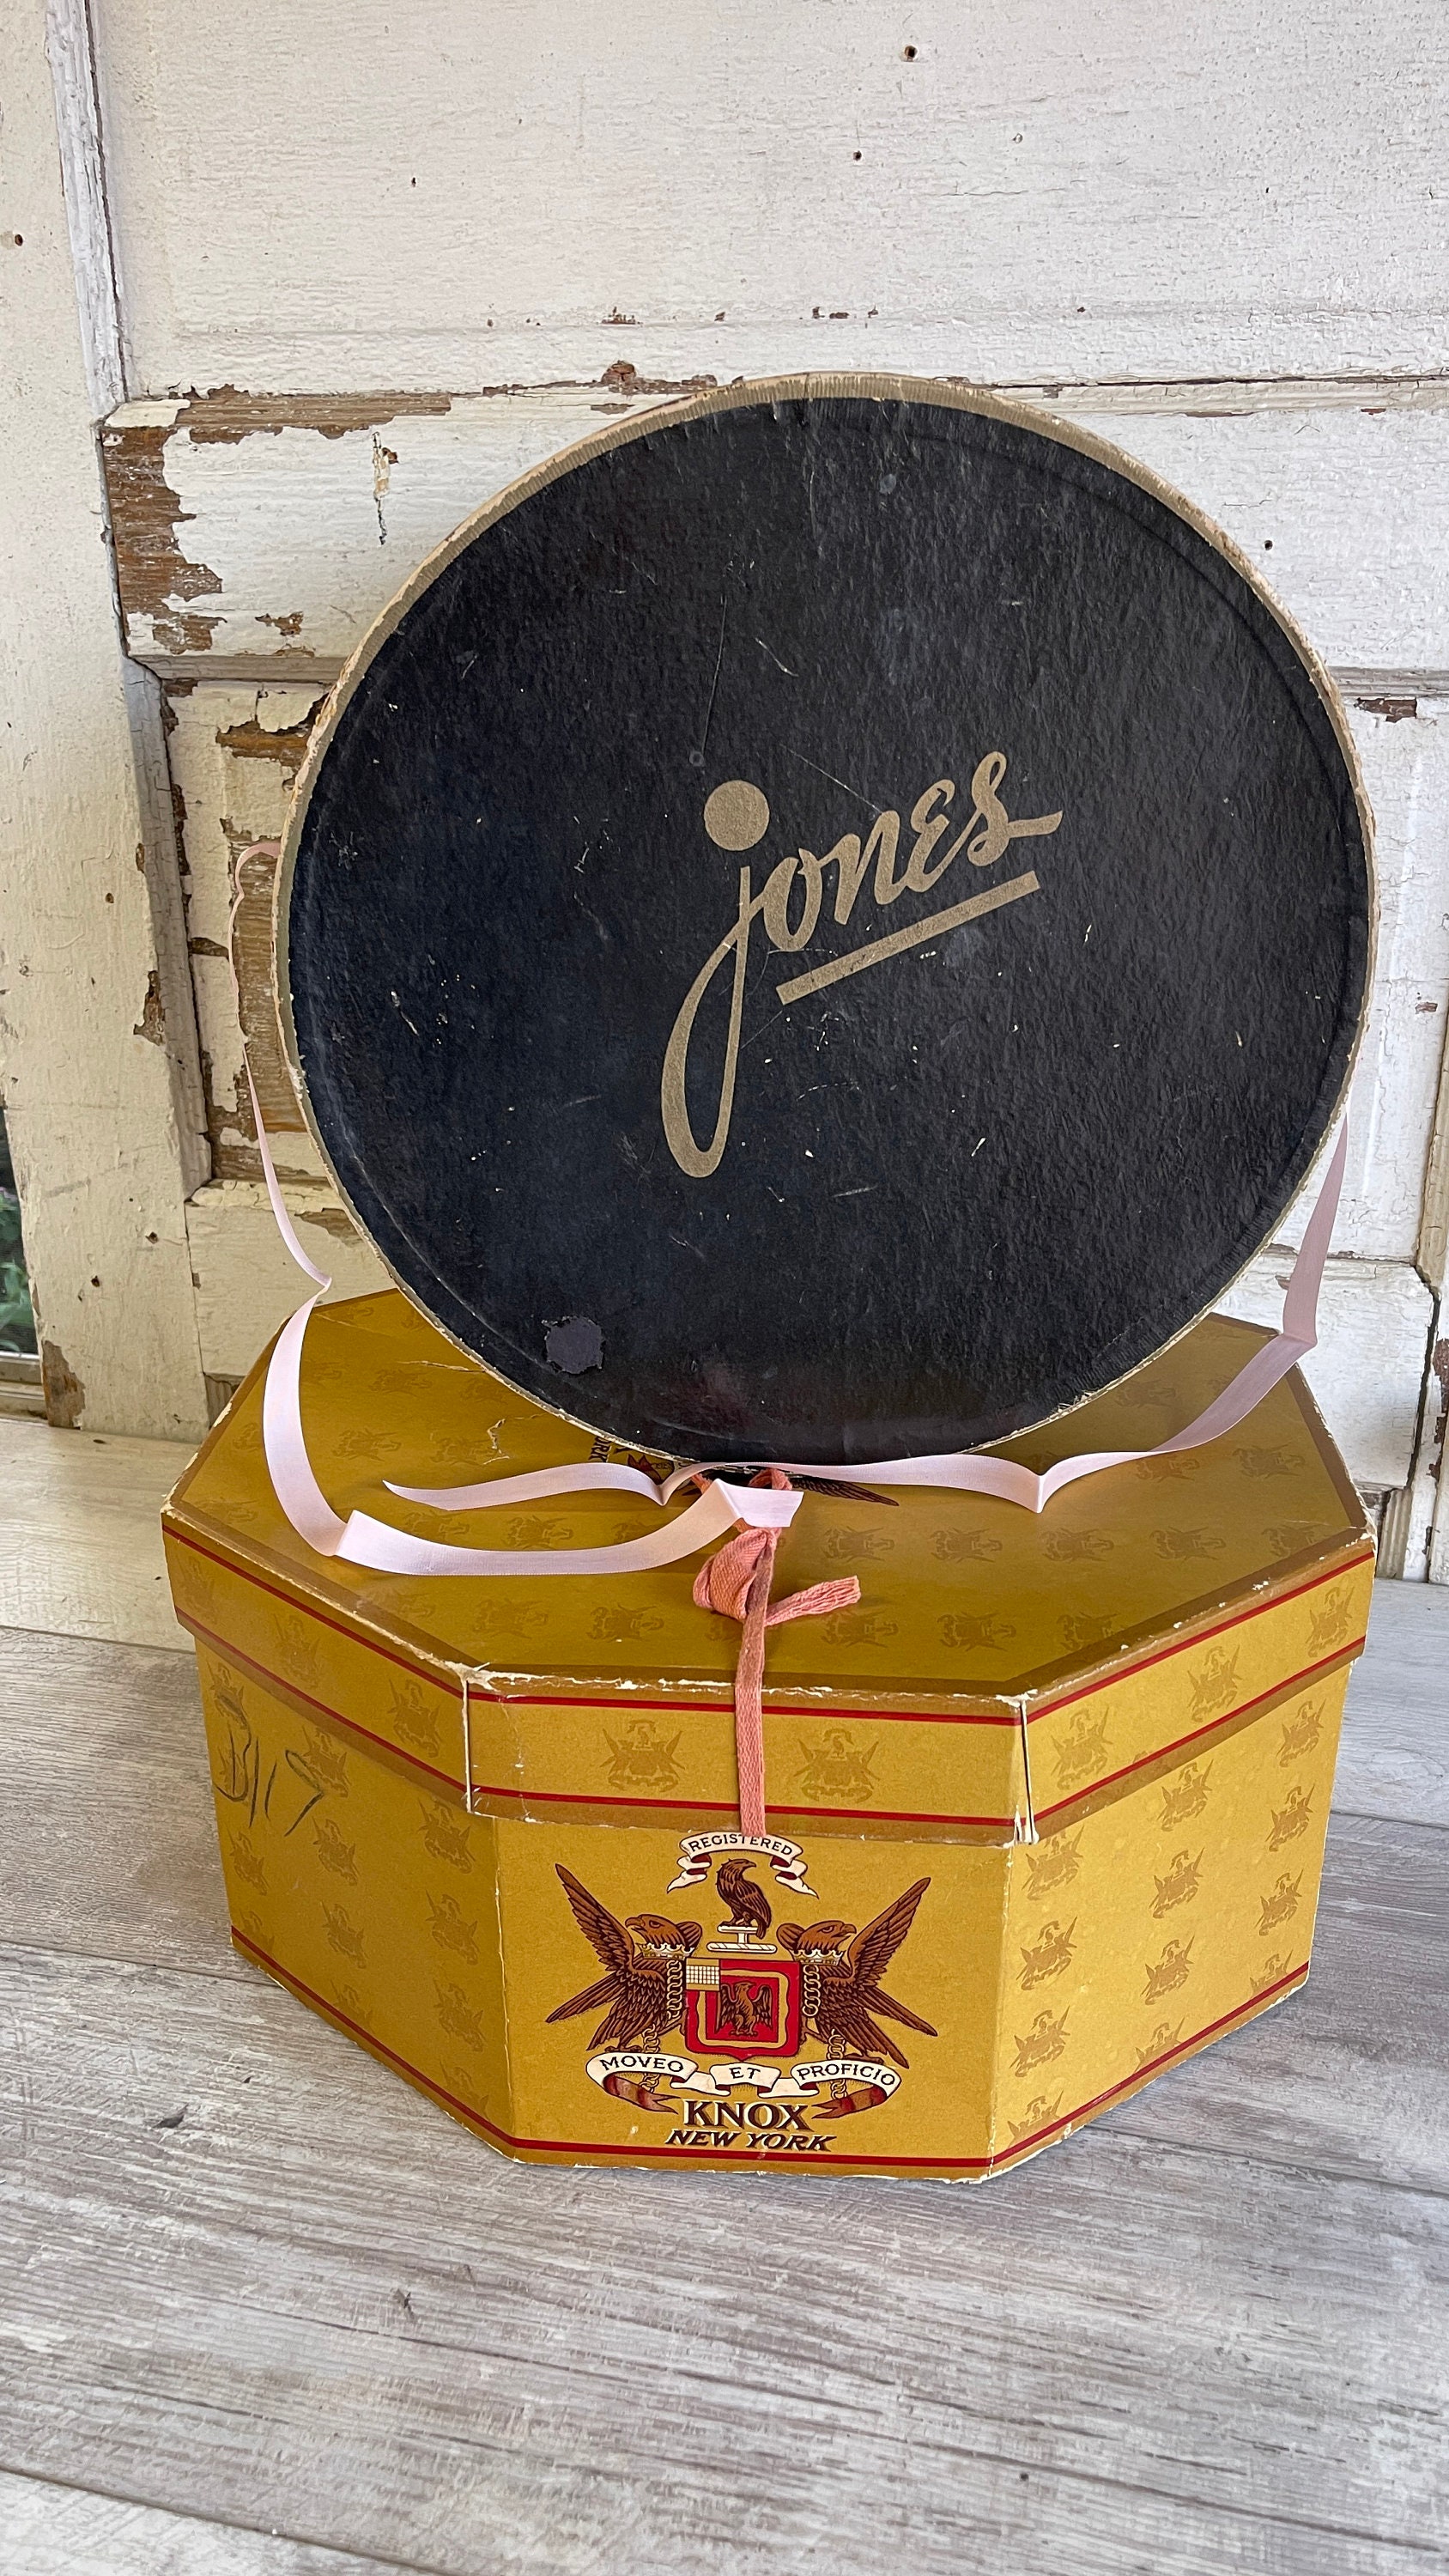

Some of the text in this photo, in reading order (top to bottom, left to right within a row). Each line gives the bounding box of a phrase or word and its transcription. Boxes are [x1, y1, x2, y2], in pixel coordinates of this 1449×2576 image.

[661, 750, 1063, 1178] jones
[688, 1833, 793, 1856] REGISTERED
[600, 2055, 896, 2087] MOVEO ET PROFICIO
[682, 2099, 815, 2134] KNOX
[664, 2129, 837, 2152] NEW YORK
